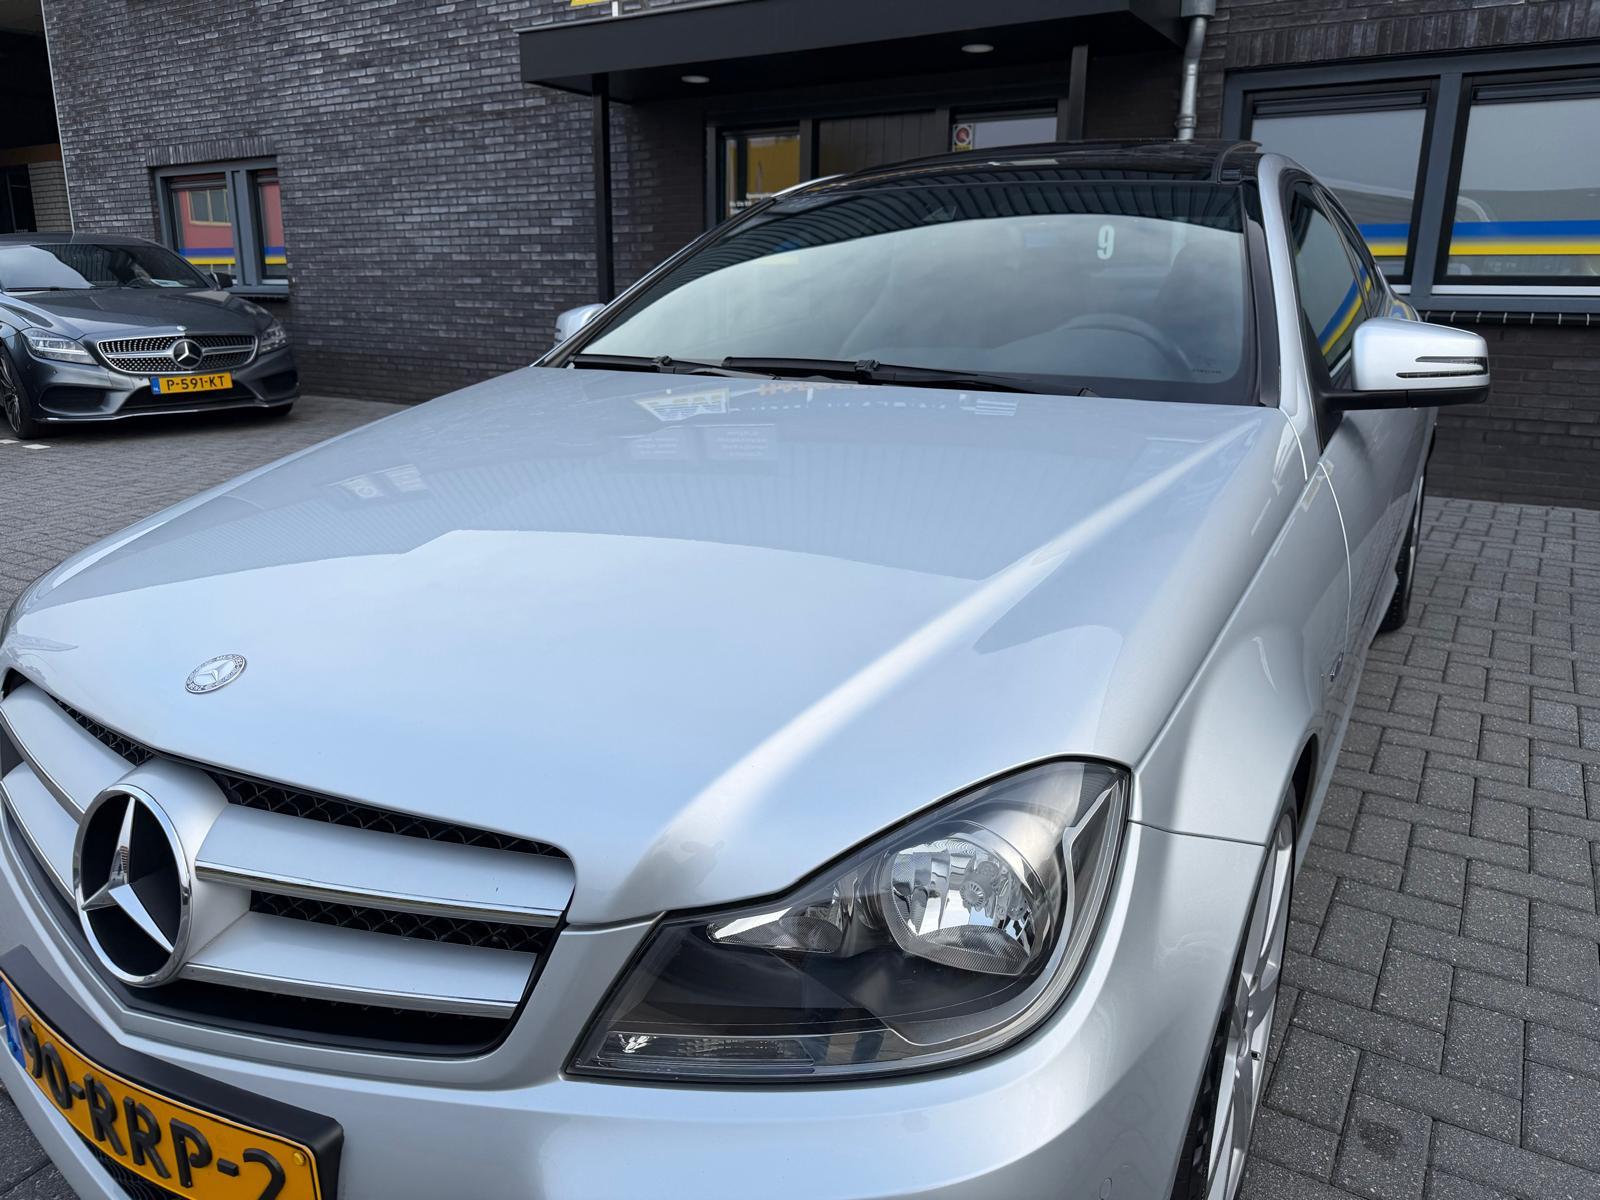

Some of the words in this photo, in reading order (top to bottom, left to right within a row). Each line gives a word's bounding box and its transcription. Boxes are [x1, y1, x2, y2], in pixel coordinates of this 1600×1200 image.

[1097, 224, 1115, 260] 9
[166, 375, 225, 391] P-591-KT
[18, 1014, 287, 1200] 90-RRP-2
